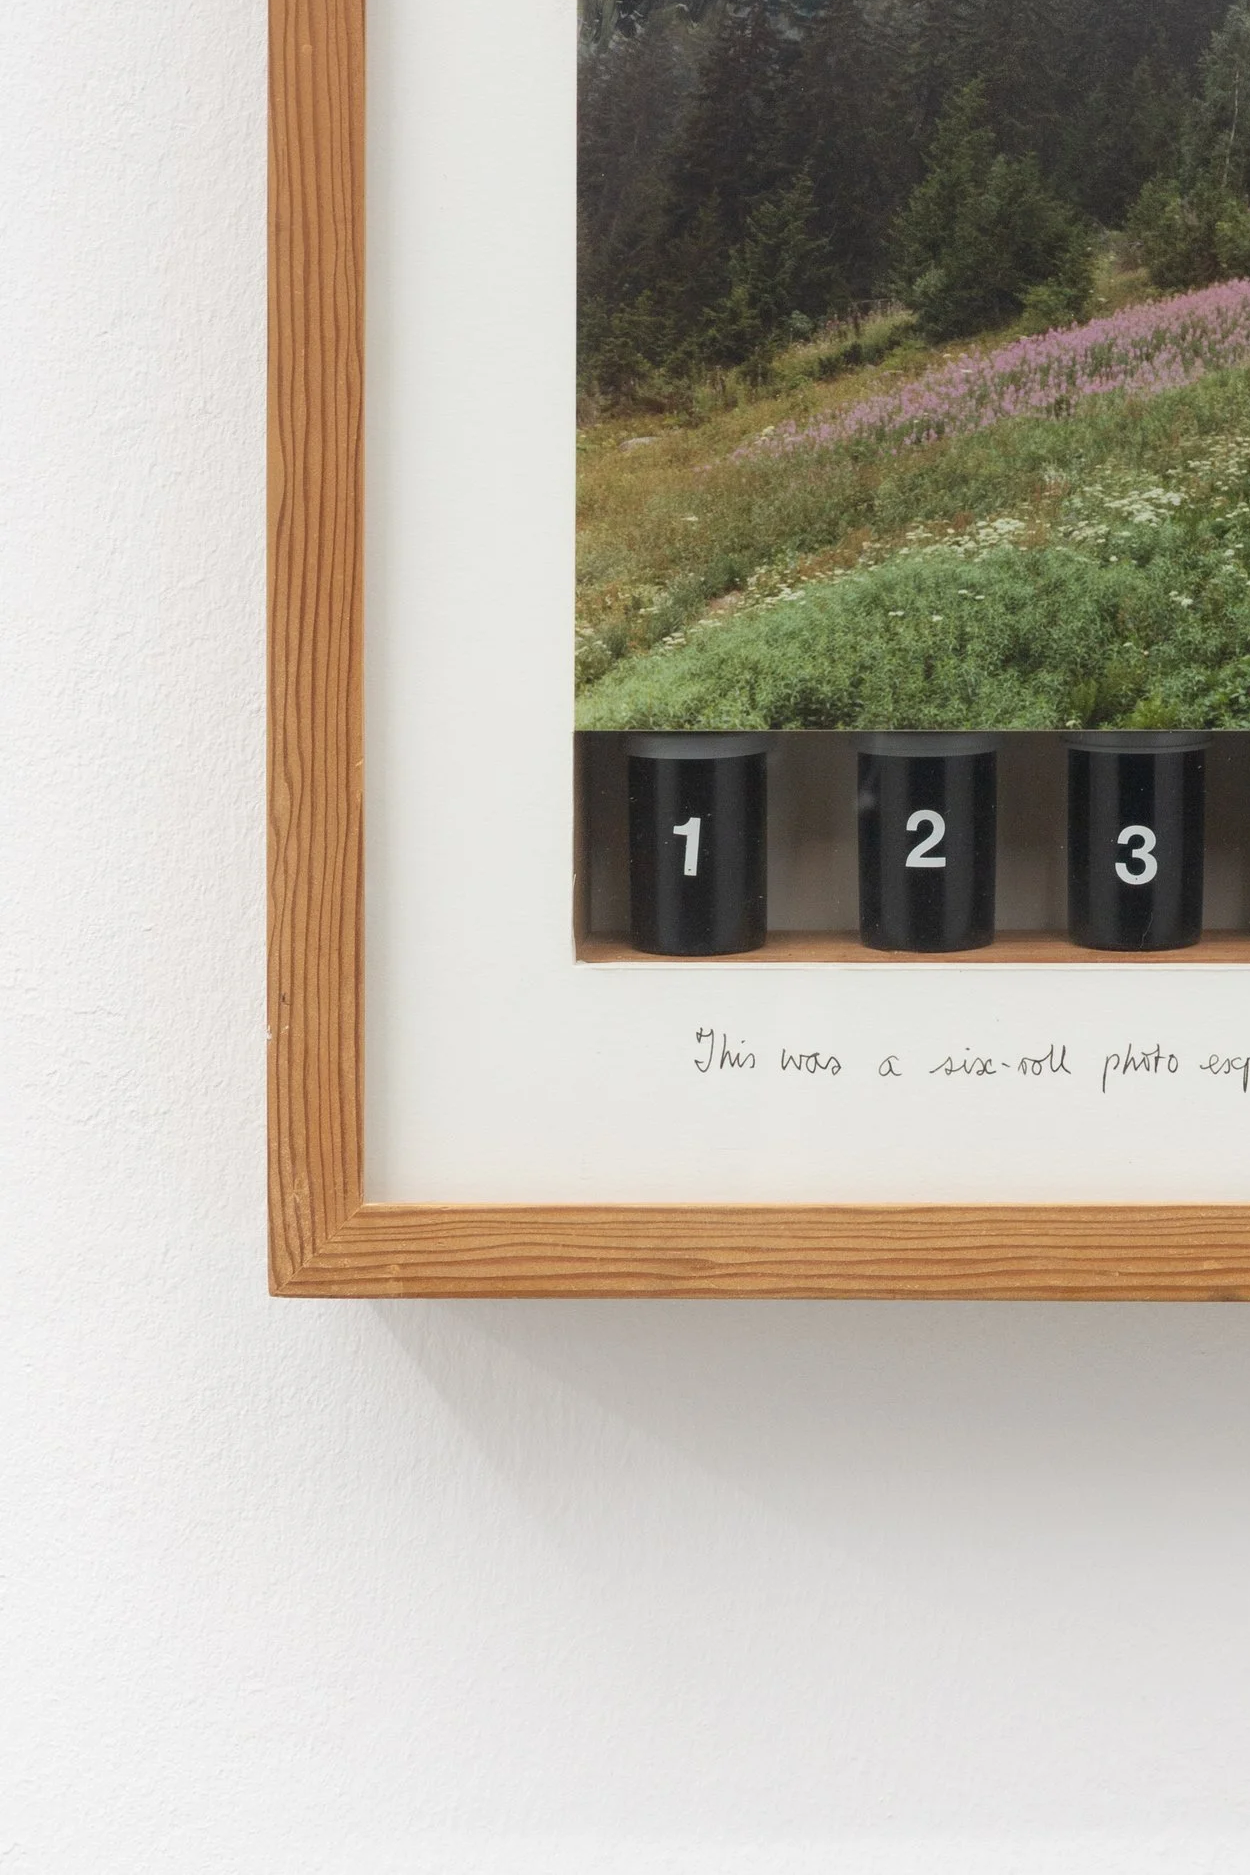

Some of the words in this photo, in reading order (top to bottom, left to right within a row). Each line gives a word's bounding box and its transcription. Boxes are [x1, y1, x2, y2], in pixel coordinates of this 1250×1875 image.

[673, 818, 700, 875] 1
[906, 810, 945, 867] 2
[1115, 826, 1157, 884] 3
[694, 1027, 755, 1073] This
[781, 1049, 841, 1076] was
[879, 1055, 902, 1076] a
[929, 1044, 1071, 1076] six-roll
[1102, 1043, 1178, 1093] photo
